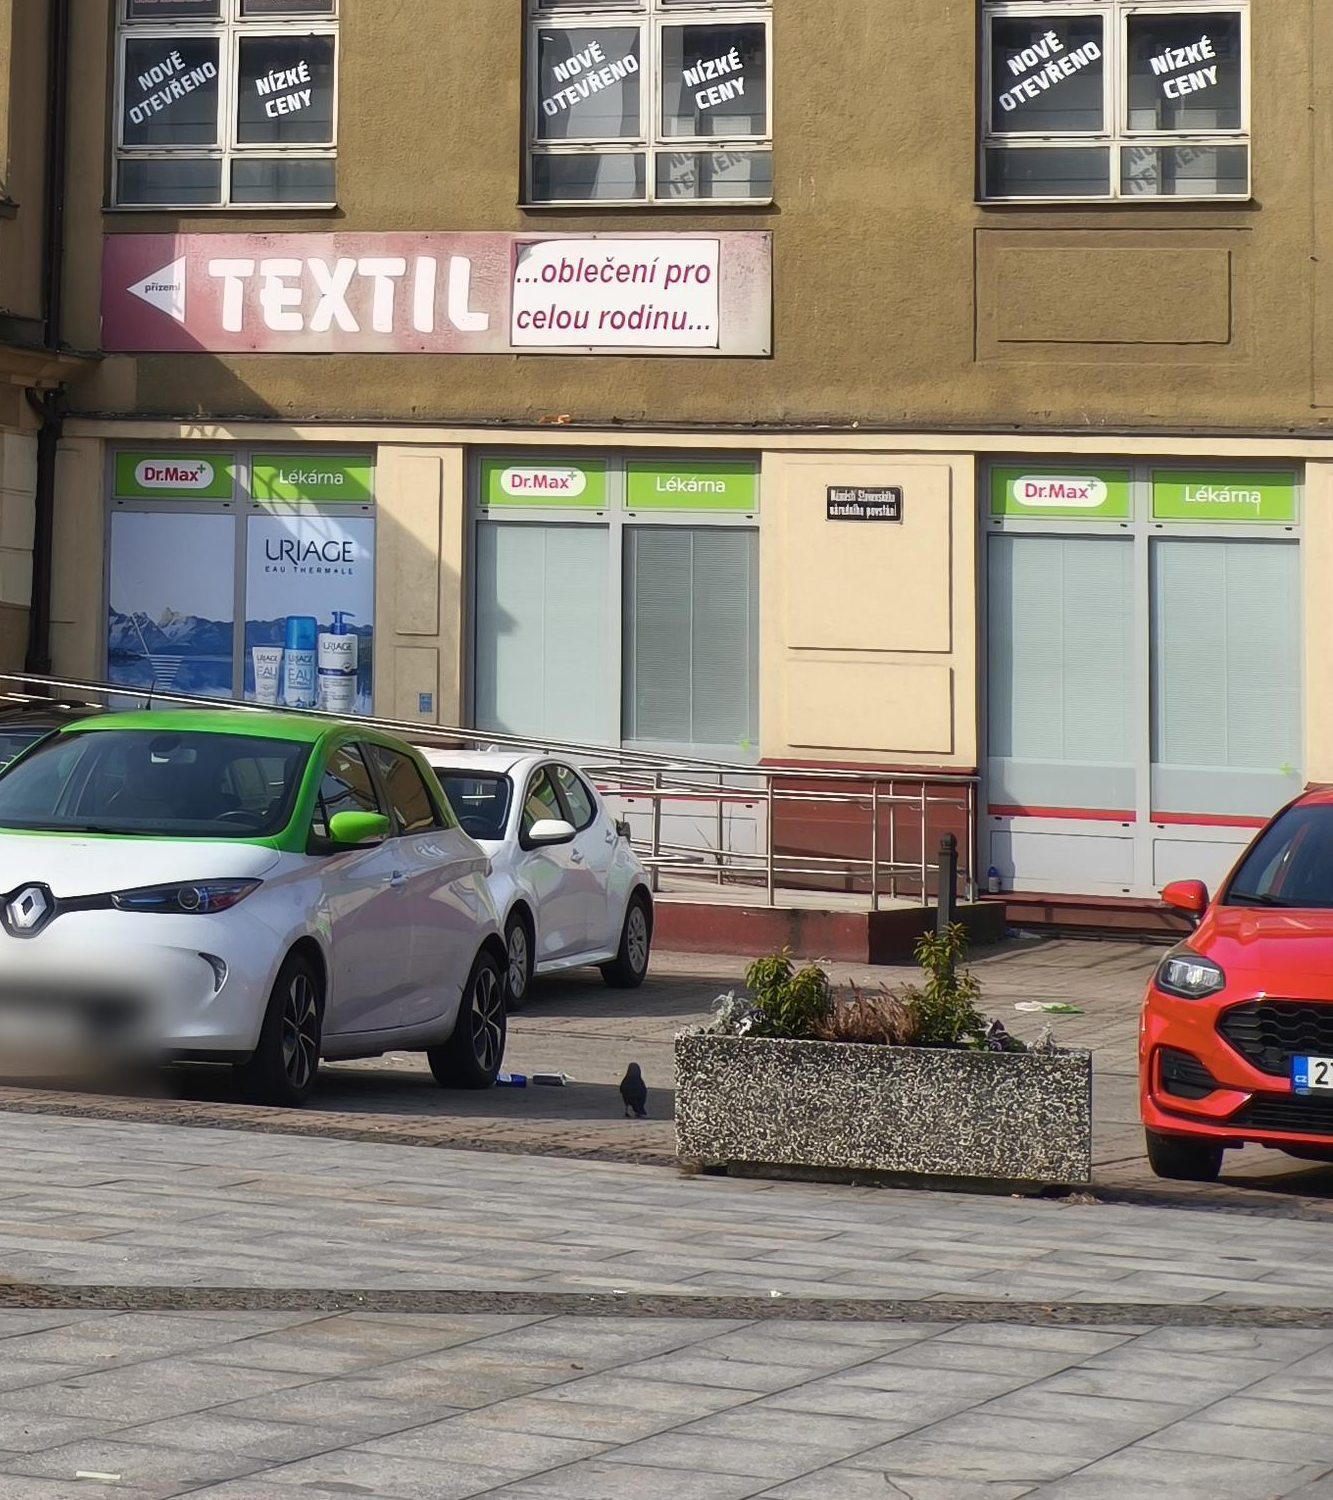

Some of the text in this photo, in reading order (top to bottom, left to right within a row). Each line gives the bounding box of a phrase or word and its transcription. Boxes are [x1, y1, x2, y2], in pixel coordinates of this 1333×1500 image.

[553, 41, 605, 83] NOVĚ
[683, 47, 743, 87] NÍZKÉ
[1007, 30, 1064, 76] NOVĚ
[1149, 35, 1216, 75] NÍZKÉ
[138, 51, 185, 91] NOVĚ
[256, 60, 311, 95] NÍZKÉ
[543, 54, 638, 116] OTEVŘENO
[999, 42, 1101, 111] OTEVŘENO
[1163, 65, 1218, 99] CENY
[130, 62, 217, 124] OTEVŘENO
[265, 89, 311, 118] CENY
[695, 77, 745, 110] CENY
[208, 256, 489, 332] TEXTIL
[664, 264, 711, 290] pro
[517, 304, 590, 329] celou
[280, 469, 343, 485] Lékárna
[656, 476, 725, 493] Lékárna
[1185, 485, 1261, 503] Lékárna
[265, 539, 354, 565] URIAGE
